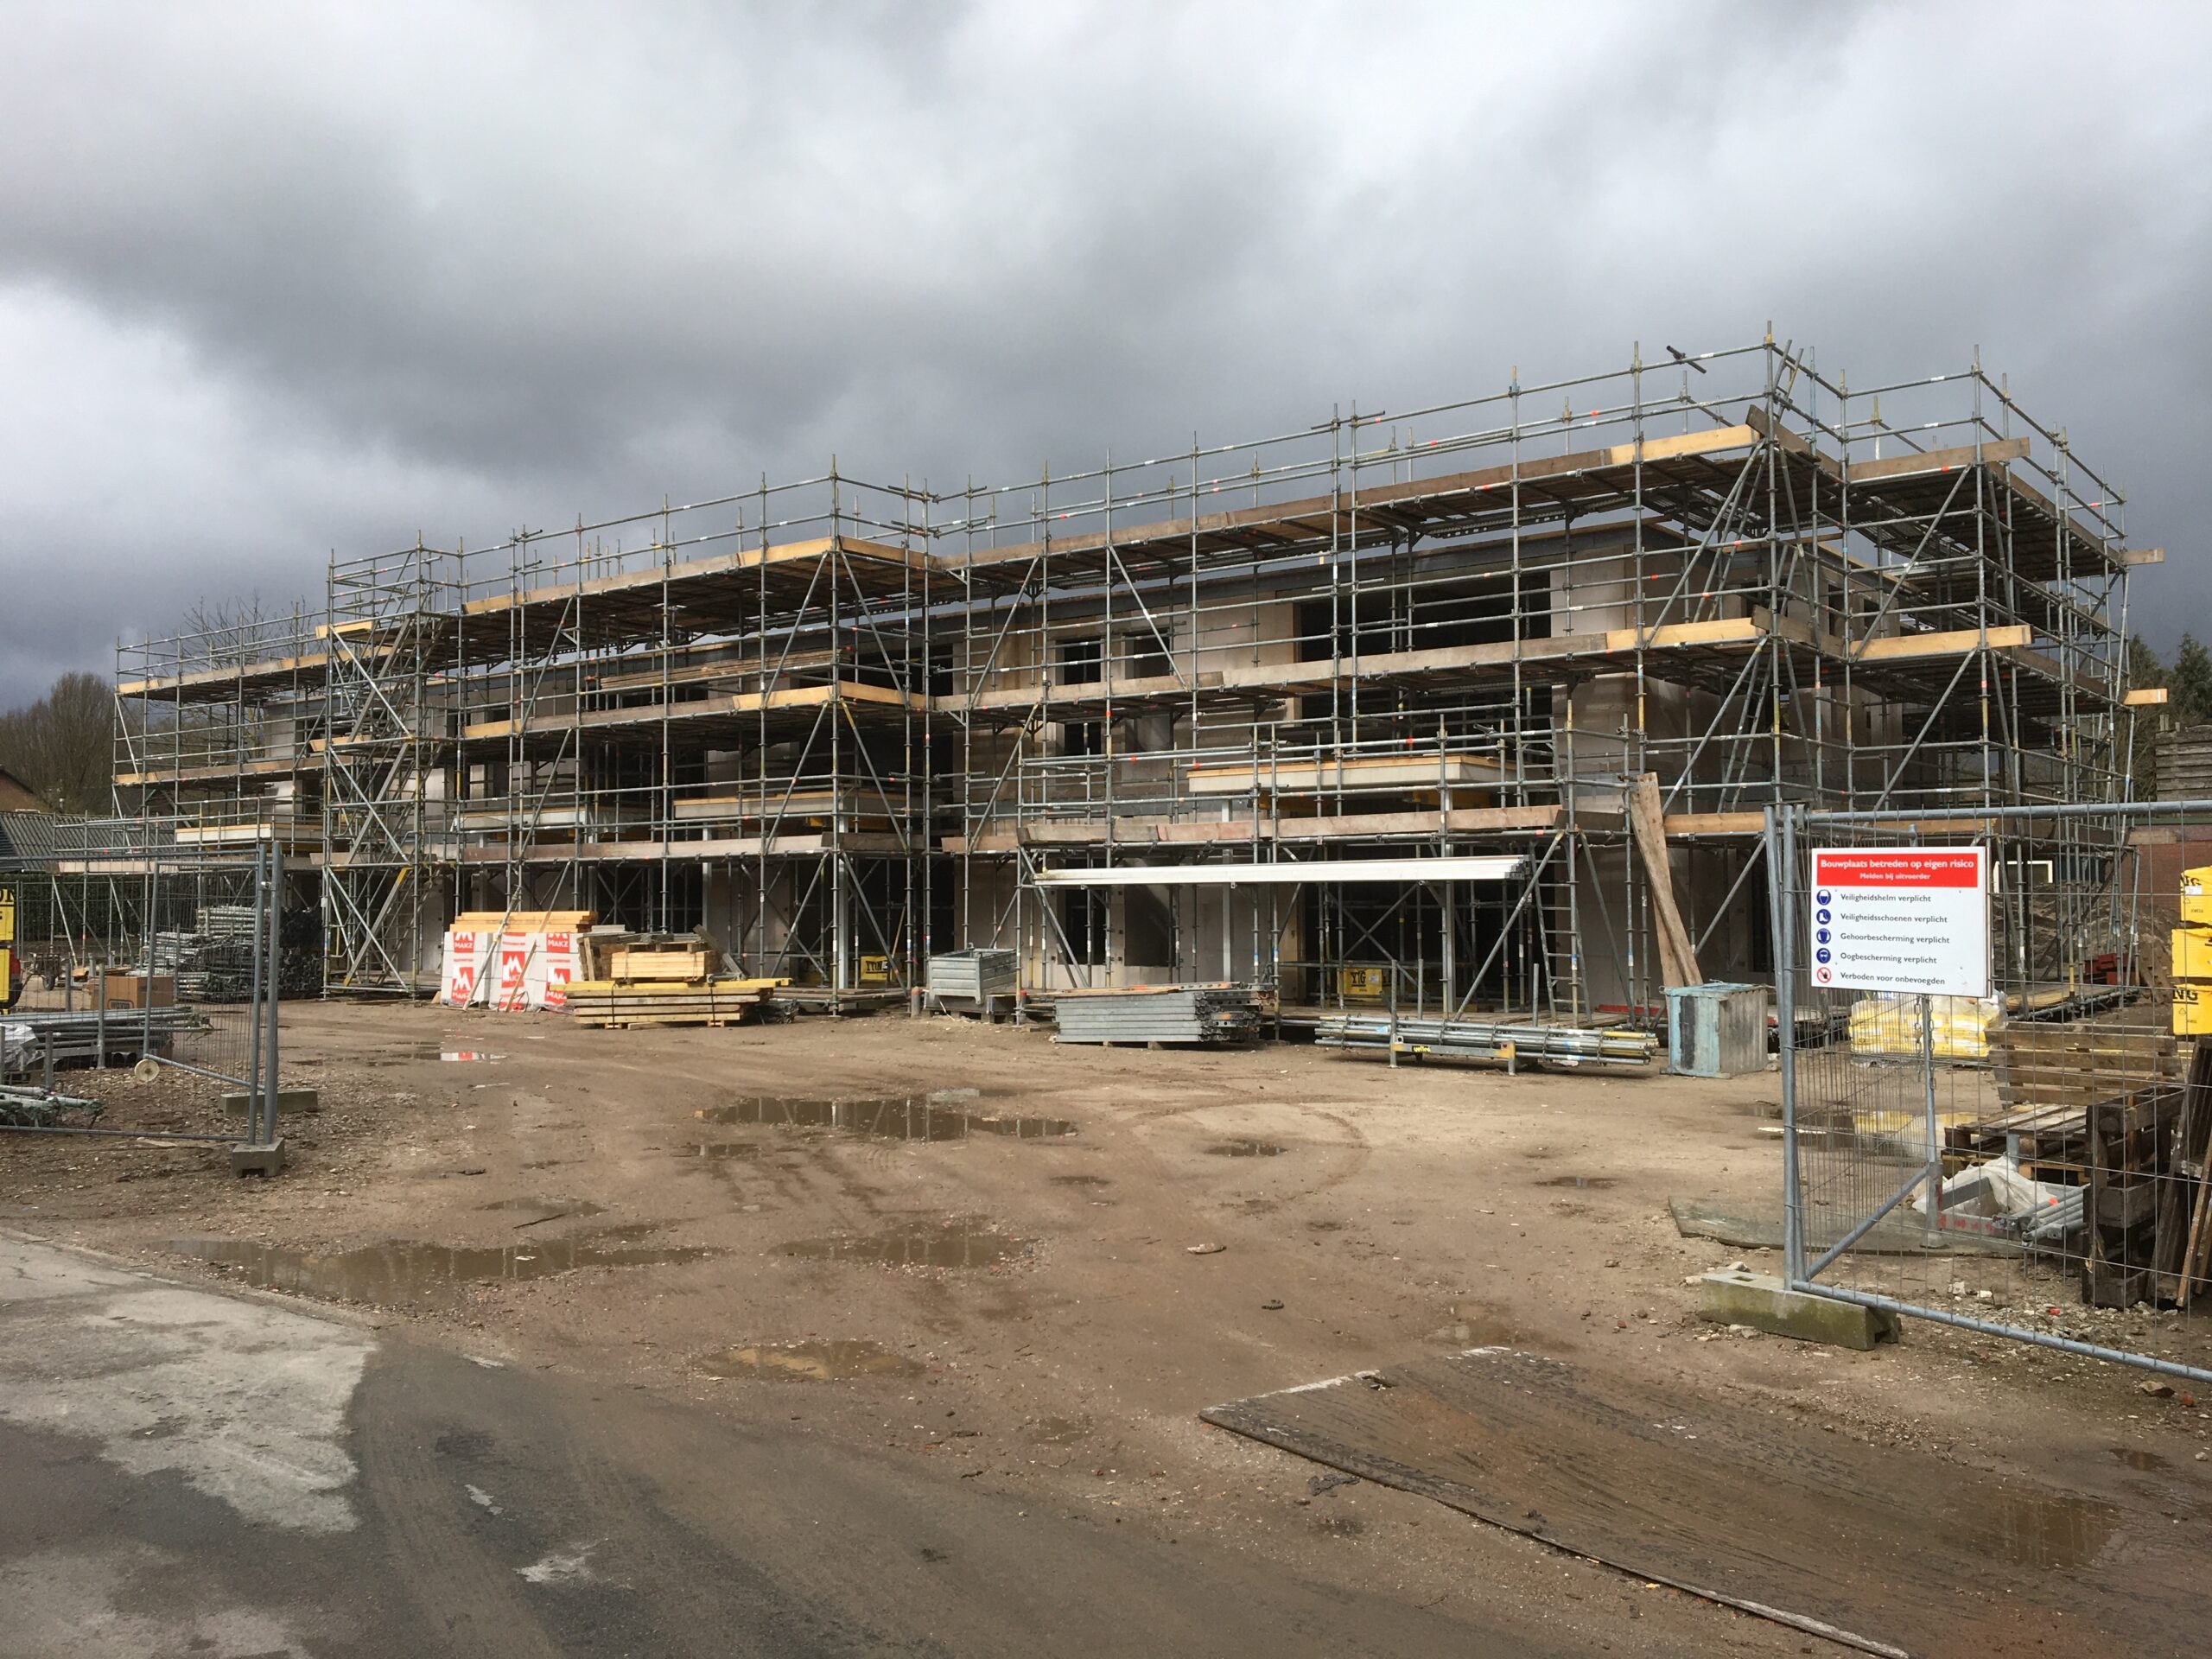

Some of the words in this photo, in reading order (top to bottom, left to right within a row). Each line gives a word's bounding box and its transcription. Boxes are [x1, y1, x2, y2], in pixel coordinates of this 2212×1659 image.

[1821, 859, 1867, 870] Bouwplaats
[1870, 859, 1908, 868] betreden
[1910, 861, 1922, 870] op
[1923, 859, 1948, 870] eigen
[1950, 859, 1974, 868] risico
[1840, 893, 1896, 902] Veiligheidshelm
[1898, 894, 1931, 904] verplicht
[1840, 912, 1912, 922] Veiligheidsschoenen
[1914, 915, 1948, 924] verplicht
[1840, 933, 1915, 944] Gehoorbescherming
[1916, 936, 1950, 945] verplicht
[1840, 952, 1902, 963] Oogbescherming
[1904, 955, 1937, 964] verplicht
[1840, 972, 1874, 981] Verboden
[1895, 976, 1945, 986] onbevoegden
